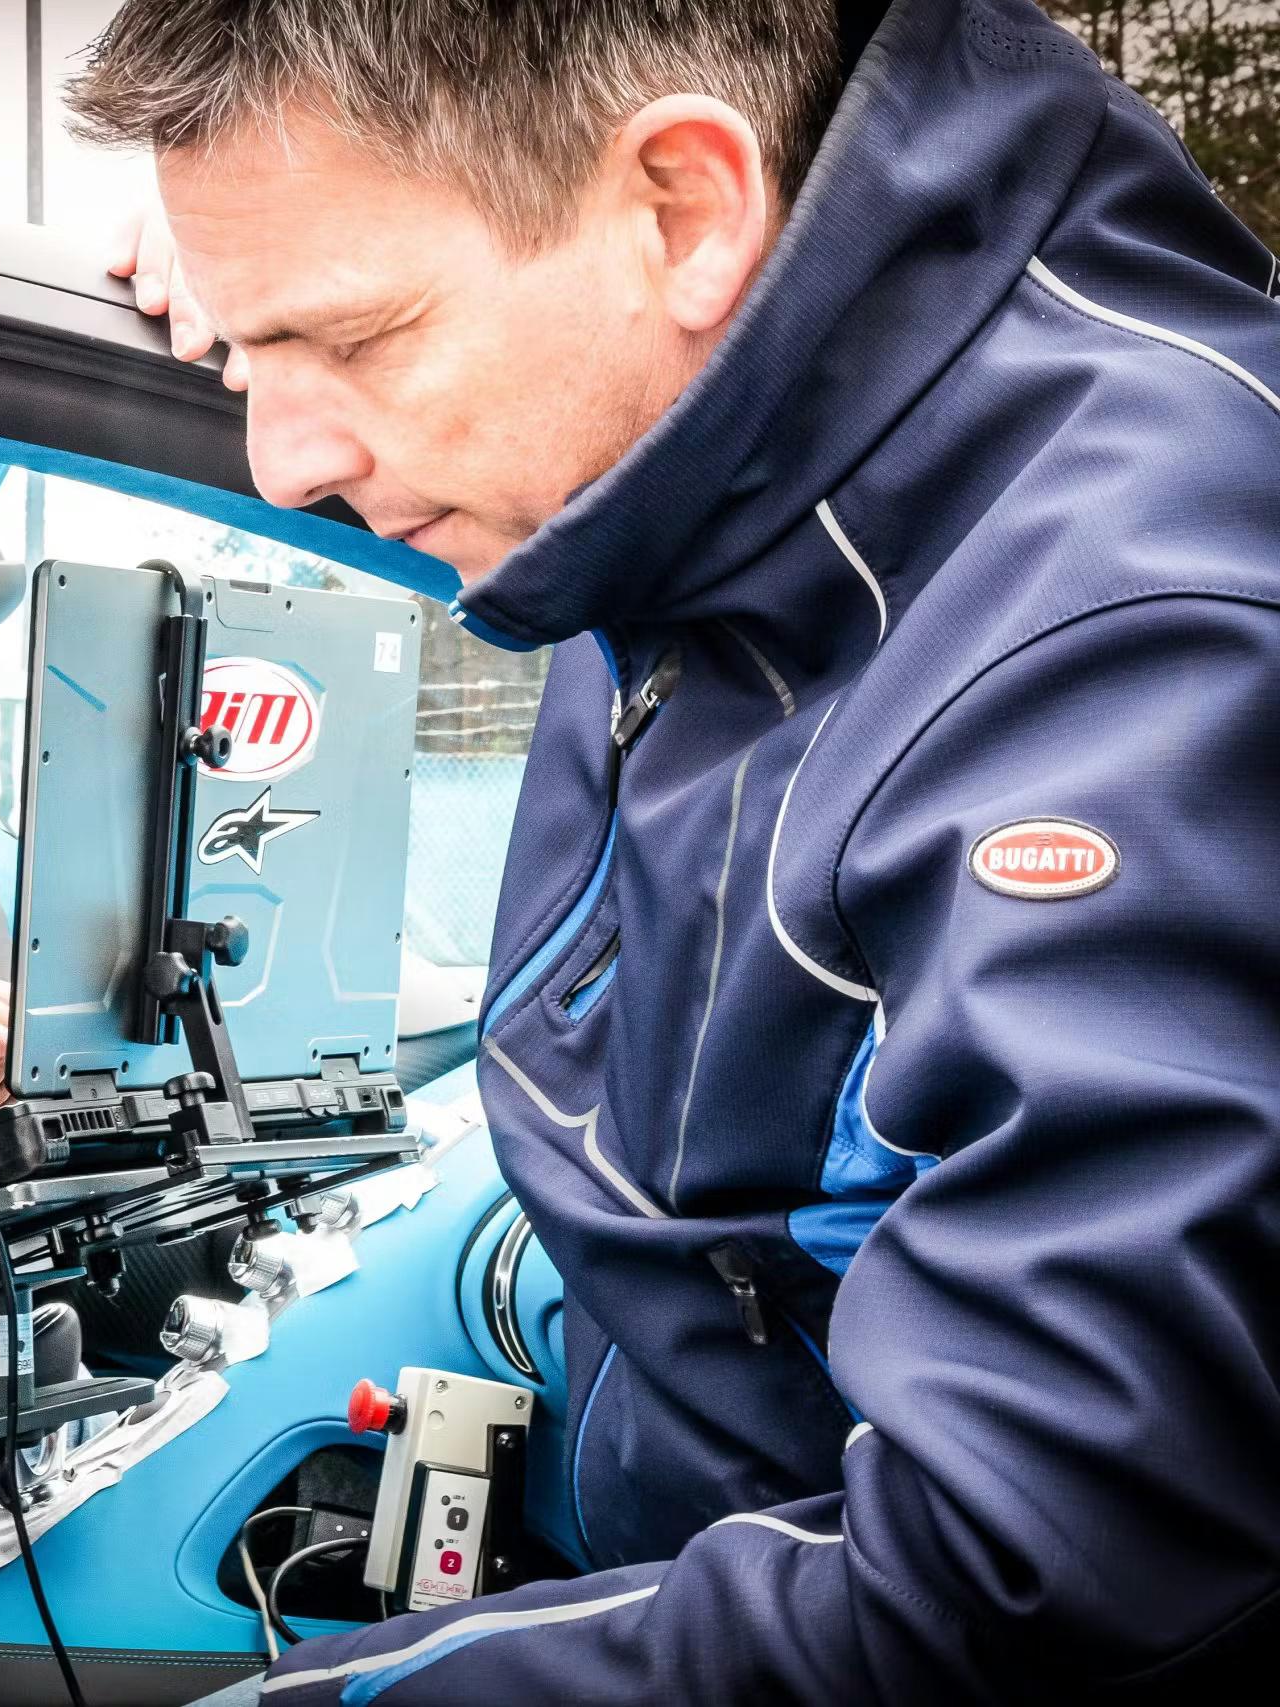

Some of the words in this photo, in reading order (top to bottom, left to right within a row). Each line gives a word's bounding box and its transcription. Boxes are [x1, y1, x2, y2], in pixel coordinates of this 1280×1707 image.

[989, 848, 1095, 872] BUGATTI
[455, 1514, 461, 1525] 1
[448, 1559, 455, 1567] 2
